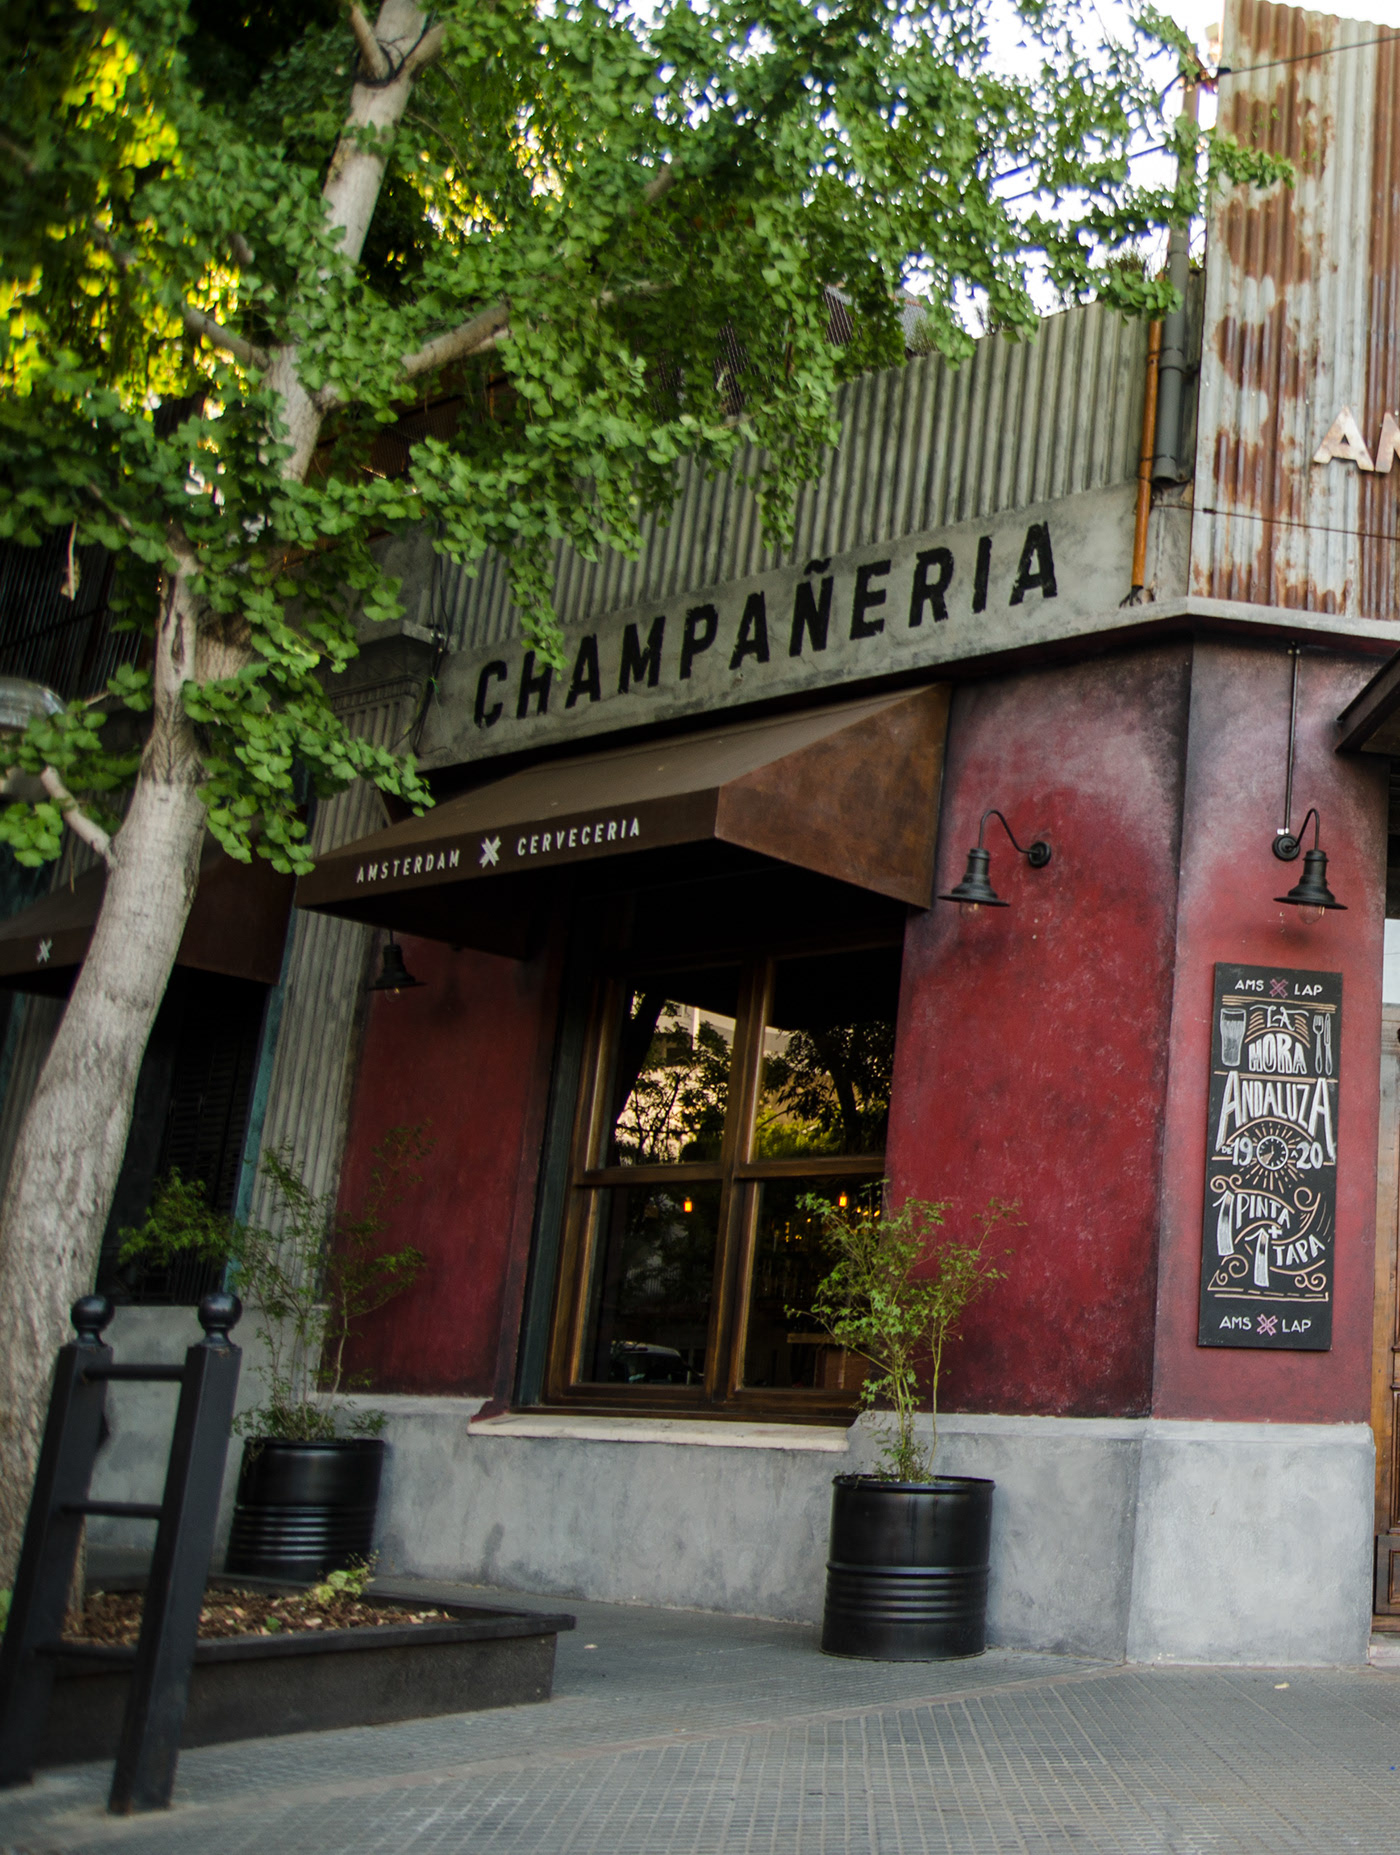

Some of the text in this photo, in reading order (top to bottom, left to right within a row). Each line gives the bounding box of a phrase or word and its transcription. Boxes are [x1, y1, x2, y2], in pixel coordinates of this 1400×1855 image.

[473, 520, 1058, 729] CHAMPAÑERIA
[356, 817, 640, 884] AMSTERDAM CERVECERIA
[1234, 979, 1323, 996] AMS LAP
[1248, 1033, 1308, 1075] HORA
[1215, 1070, 1337, 1164] ANDALUZA
[1221, 1136, 1324, 1170] DE 19 A 20
[1212, 1190, 1291, 1256] 1 PINTA
[1244, 1228, 1326, 1287] 1 TAPA
[1219, 1315, 1312, 1333] AMS LAP
